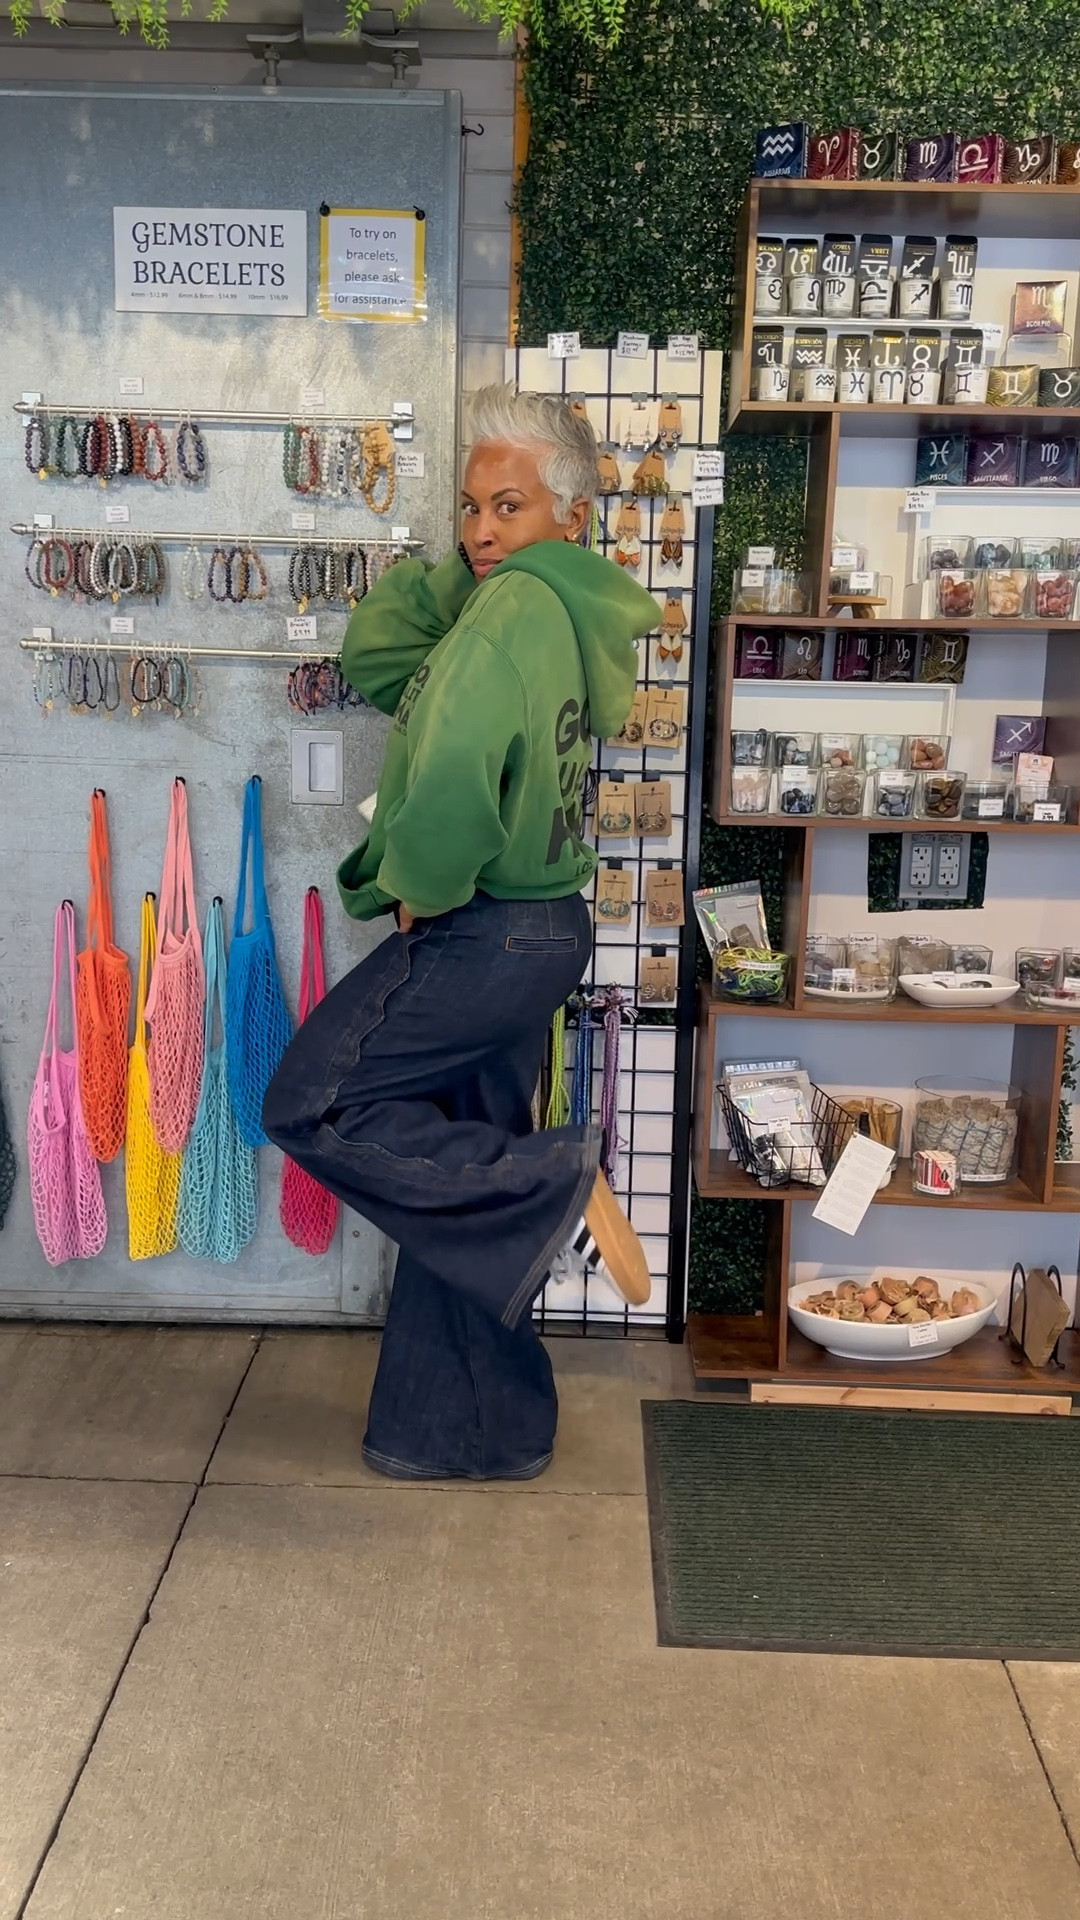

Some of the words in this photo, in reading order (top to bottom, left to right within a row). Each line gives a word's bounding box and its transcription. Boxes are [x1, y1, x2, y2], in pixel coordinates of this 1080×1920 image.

[131, 221, 284, 253] GEMSTONE
[349, 228, 362, 239] To
[365, 229, 380, 241] try
[382, 231, 397, 240] on
[346, 249, 398, 262] bracelets,
[132, 260, 285, 287] BRACELETS
[344, 272, 380, 283] please
[382, 272, 401, 284] ask
[334, 292, 351, 304] for
[352, 295, 407, 305] assistance
[1026, 320, 1050, 328] SCORPIO
[973, 474, 1008, 482] SAGITTARIUS
